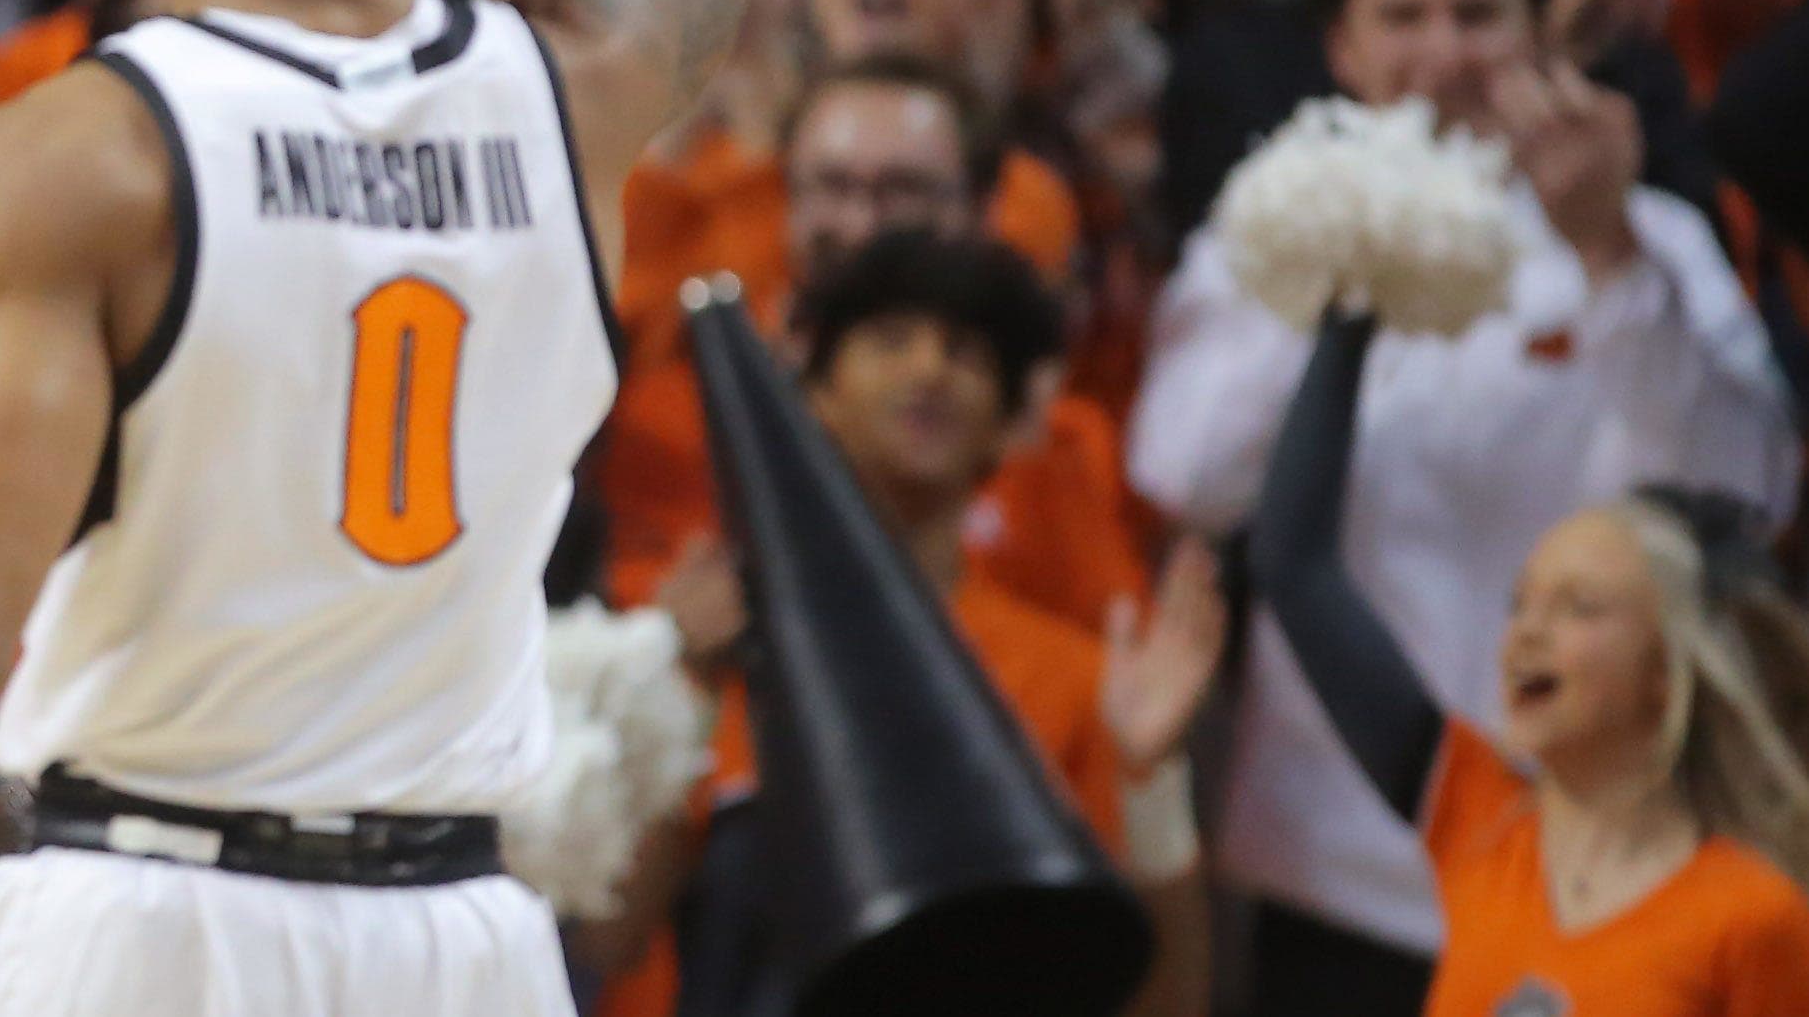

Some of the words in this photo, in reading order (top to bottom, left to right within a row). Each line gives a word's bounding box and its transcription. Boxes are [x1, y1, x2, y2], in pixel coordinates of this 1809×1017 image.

[250, 130, 473, 229] ANDERSON
[481, 136, 531, 228] III
[338, 272, 469, 569] 0
